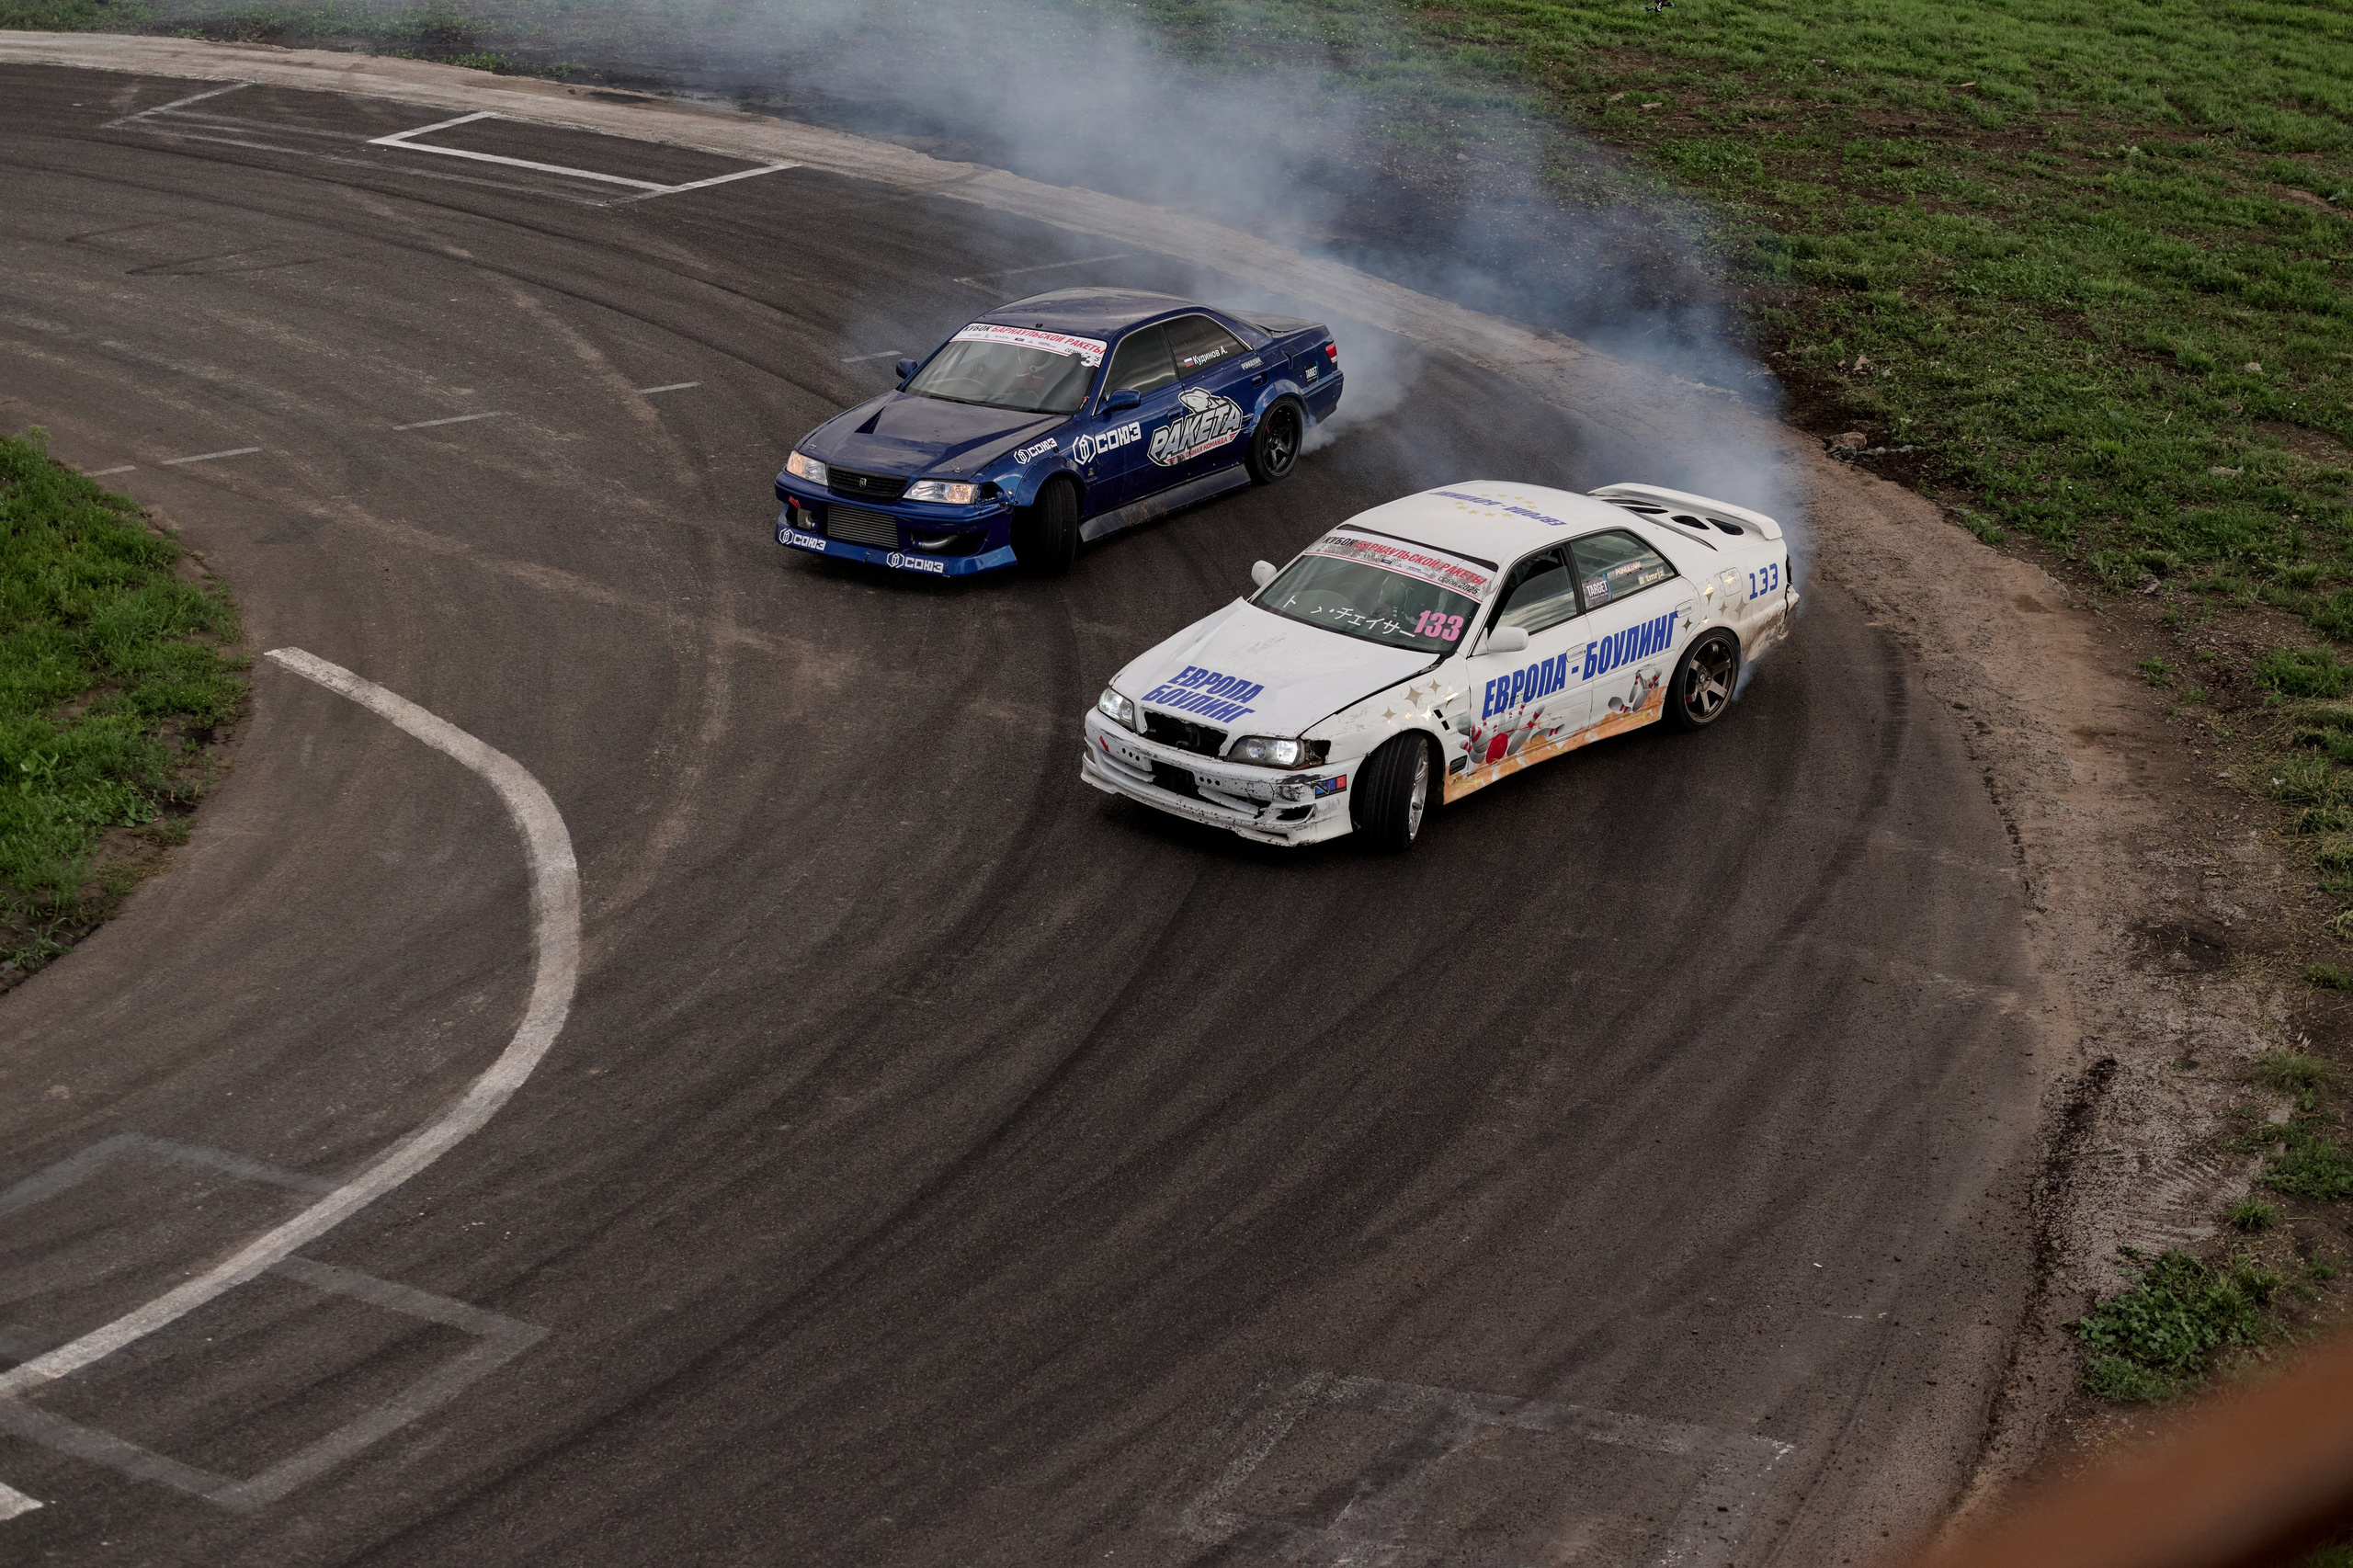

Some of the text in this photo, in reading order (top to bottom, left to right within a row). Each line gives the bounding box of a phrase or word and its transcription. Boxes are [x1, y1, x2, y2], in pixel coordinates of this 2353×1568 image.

[964, 324, 1106, 355] КУБОК БАРНАУЛЬСКОЙ РАКЕТЫ
[1193, 349, 1221, 366] Кудинов
[1305, 366, 1317, 379] TARGET
[1095, 421, 1142, 454] СОЮЗ
[1149, 403, 1242, 460] РАКЕТА
[1203, 436, 1228, 450] КОМАНДА
[1029, 437, 1058, 458] СОЮЗ
[793, 533, 826, 551] СОЮЗ
[904, 557, 944, 574] СОЮЗ
[1322, 536, 1358, 547] КУБОК
[1355, 540, 1440, 568] БАРНАУЛЬСКОЙ
[1438, 561, 1488, 585] РАКЕТЫ
[1458, 582, 1480, 595] 2025
[1586, 581, 1608, 597] TARGET
[1749, 562, 1778, 600] 133
[1414, 609, 1464, 642] 133
[1482, 653, 1567, 720] ЕВРОПА
[1582, 609, 1678, 681] БОУЛИНГ
[1166, 665, 1265, 704] ЕВРОПА
[1141, 684, 1256, 723] БОУЛИНГ
